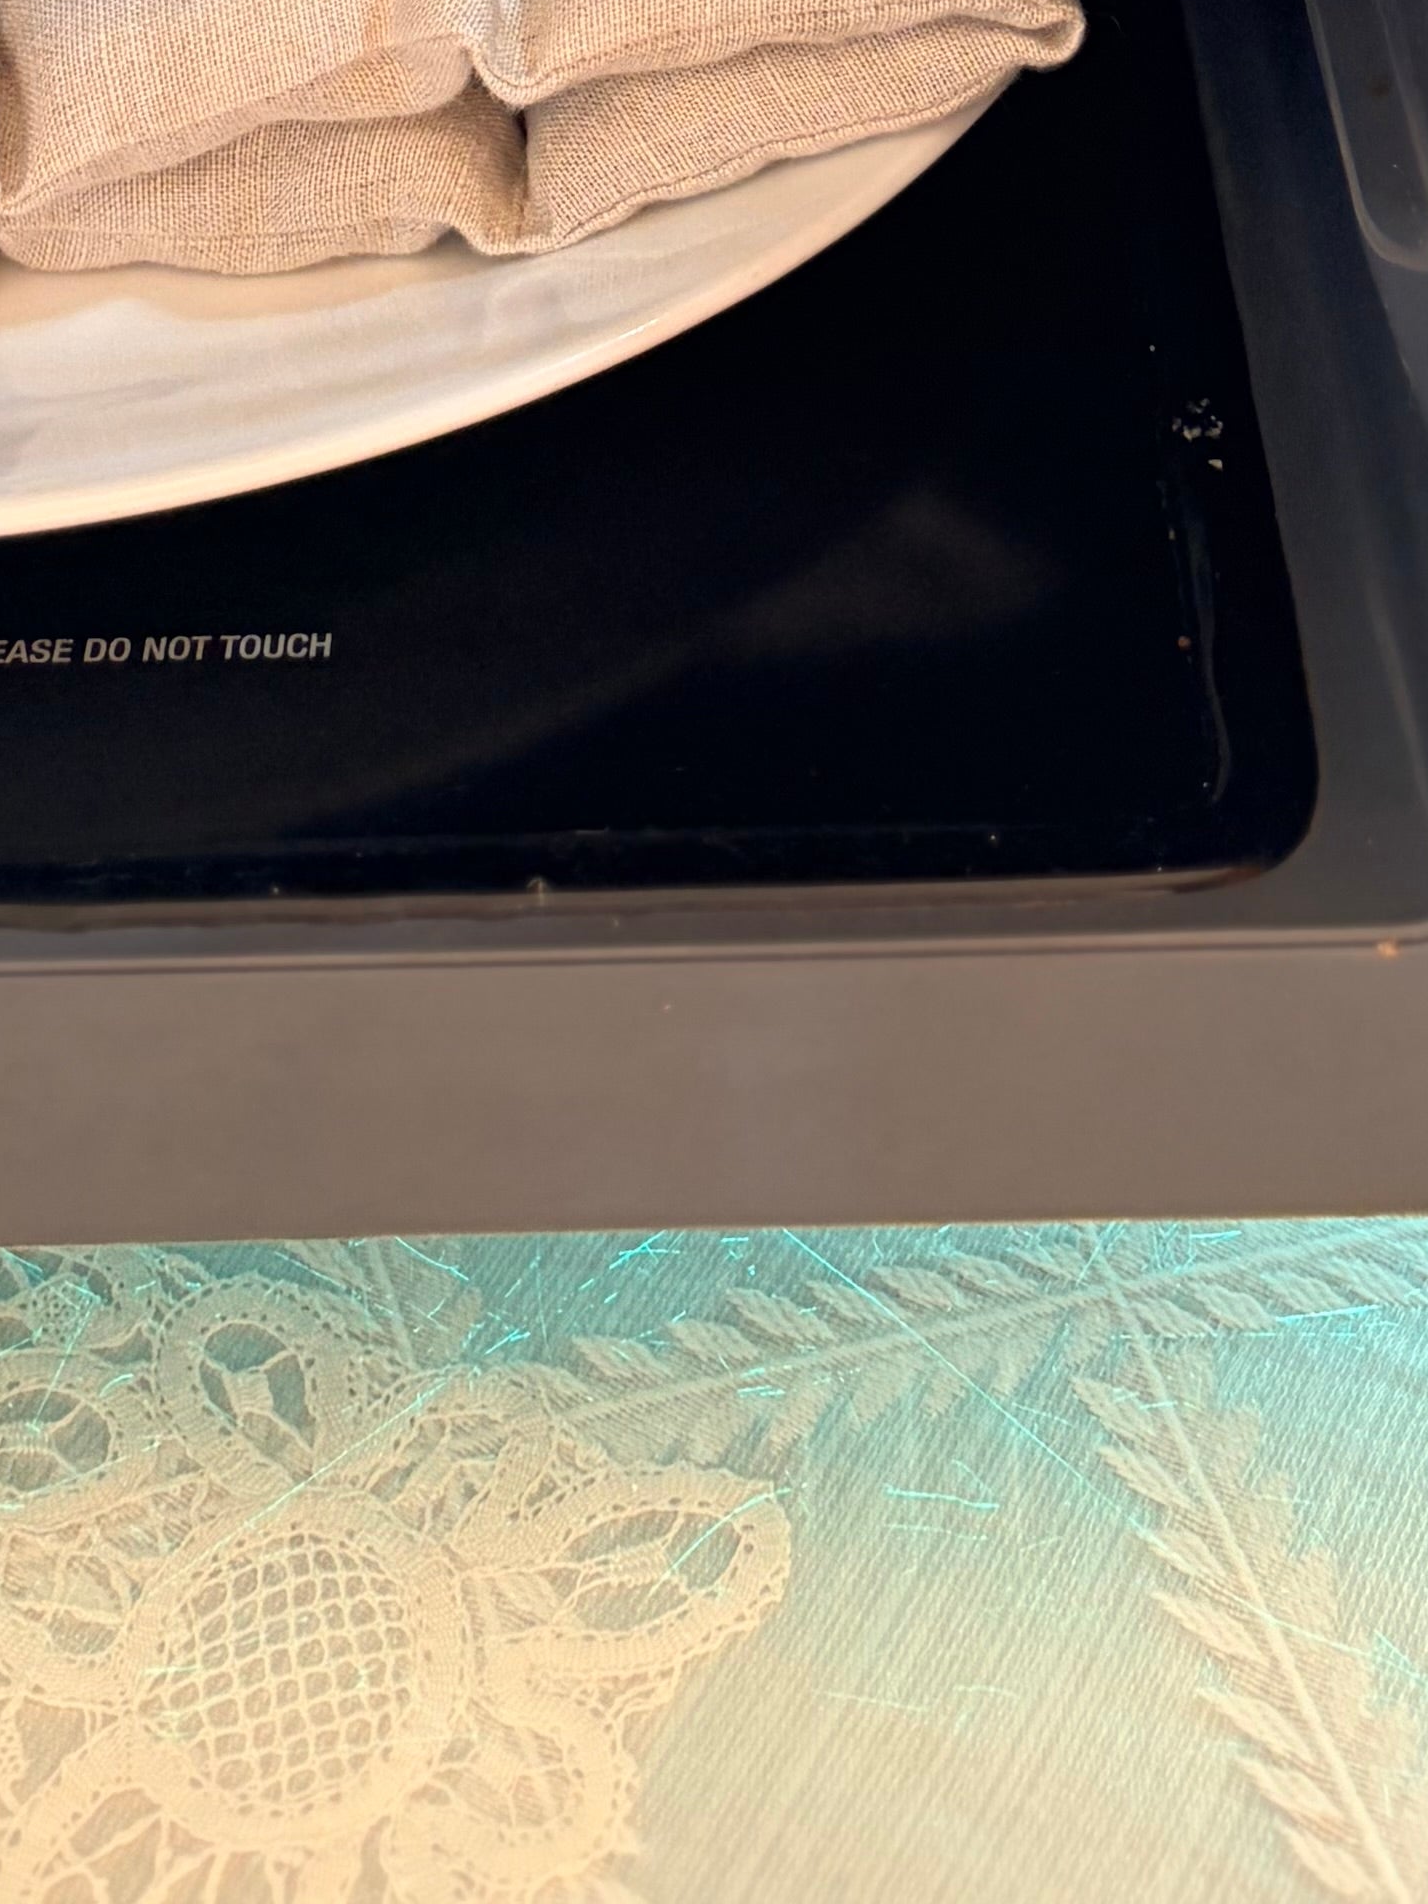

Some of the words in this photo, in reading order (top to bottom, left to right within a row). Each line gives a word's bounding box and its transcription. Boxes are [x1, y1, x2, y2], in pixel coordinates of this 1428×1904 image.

[83, 637, 132, 663] DO
[142, 635, 213, 662] NOT
[219, 632, 332, 660] TOUCH
